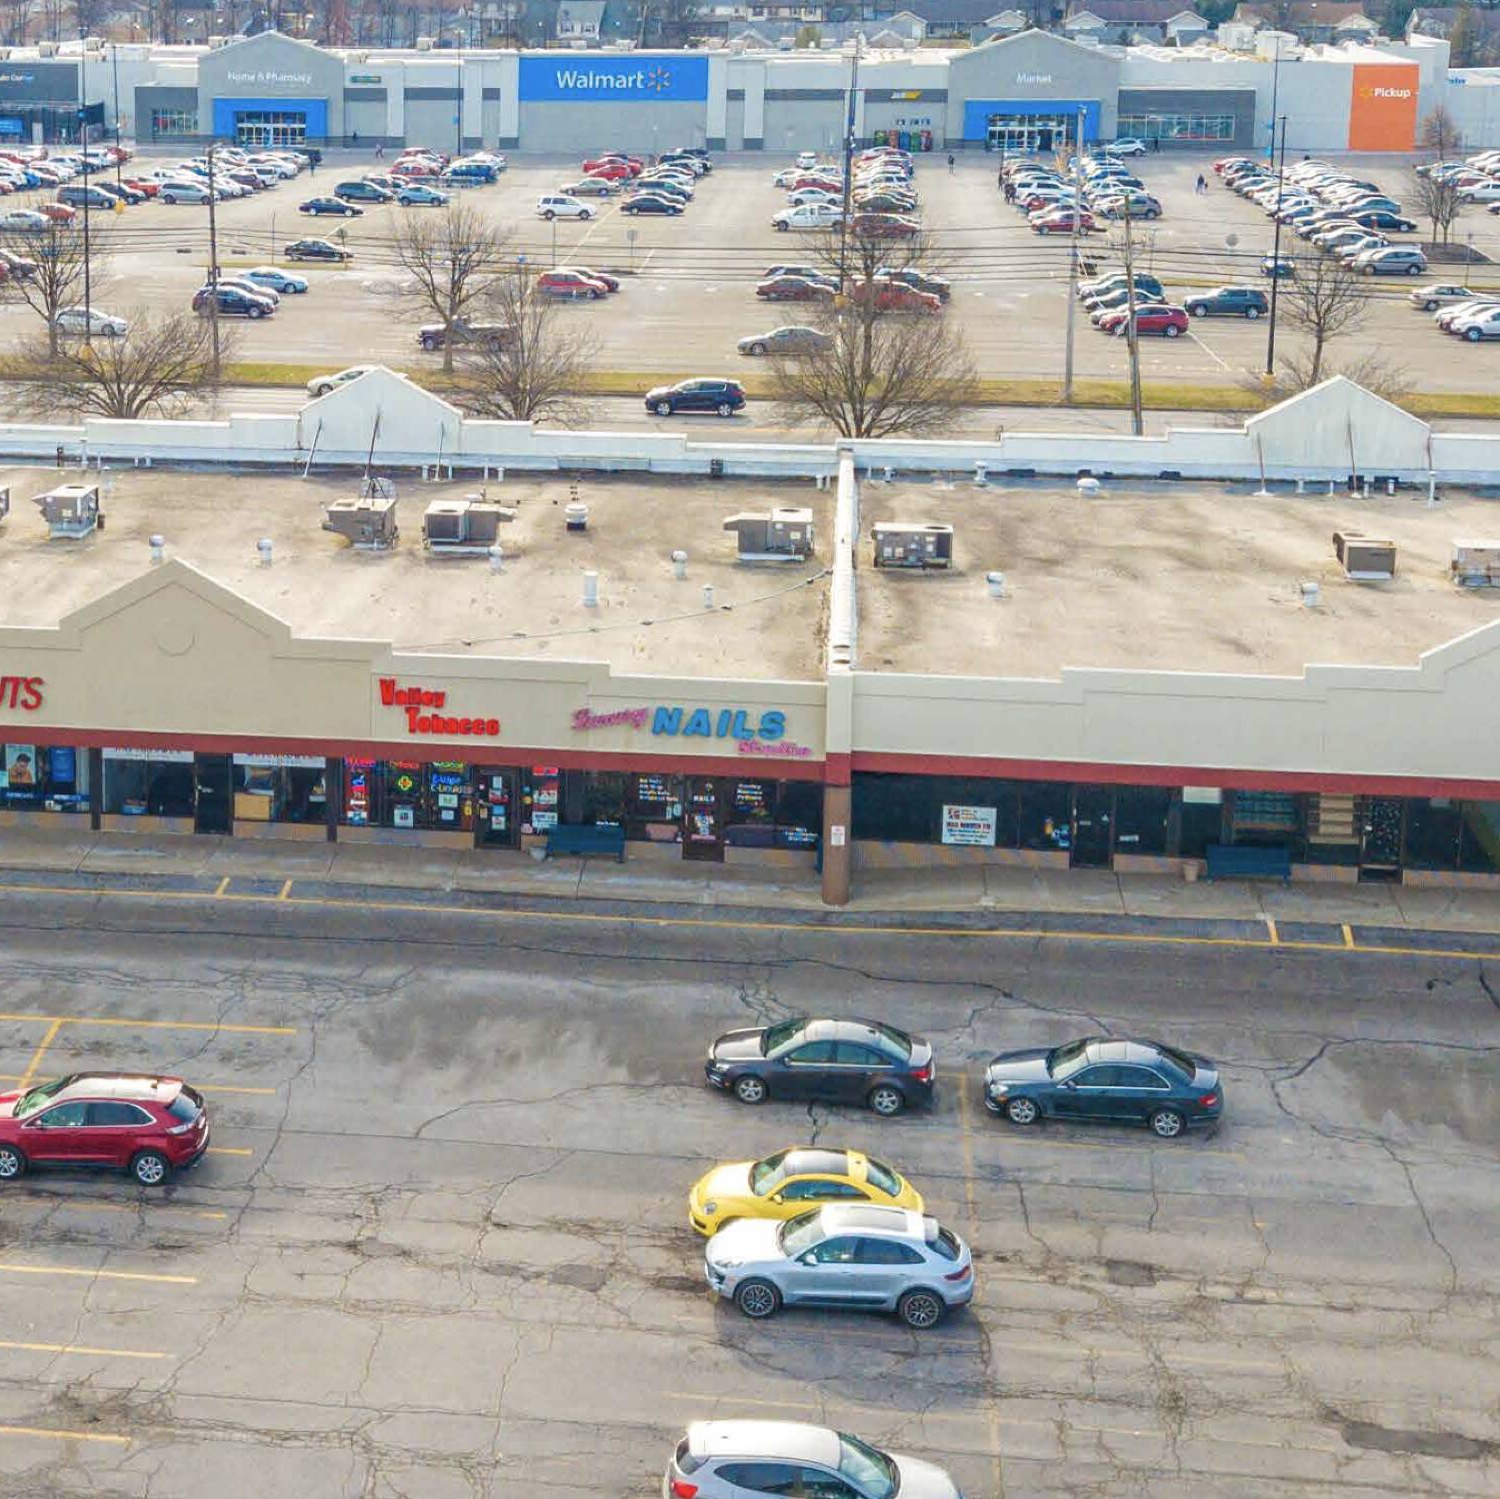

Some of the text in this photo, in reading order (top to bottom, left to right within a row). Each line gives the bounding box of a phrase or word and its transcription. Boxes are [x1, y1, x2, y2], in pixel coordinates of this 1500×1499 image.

[227, 71, 255, 81] Home
[266, 72, 313, 84] Pharmacy
[556, 70, 645, 89] Walmart
[1016, 74, 1052, 84] Market
[1374, 88, 1411, 99] Pickup
[379, 678, 447, 708] Valley
[404, 706, 500, 736] Tobacco
[651, 706, 788, 740] NAILS
